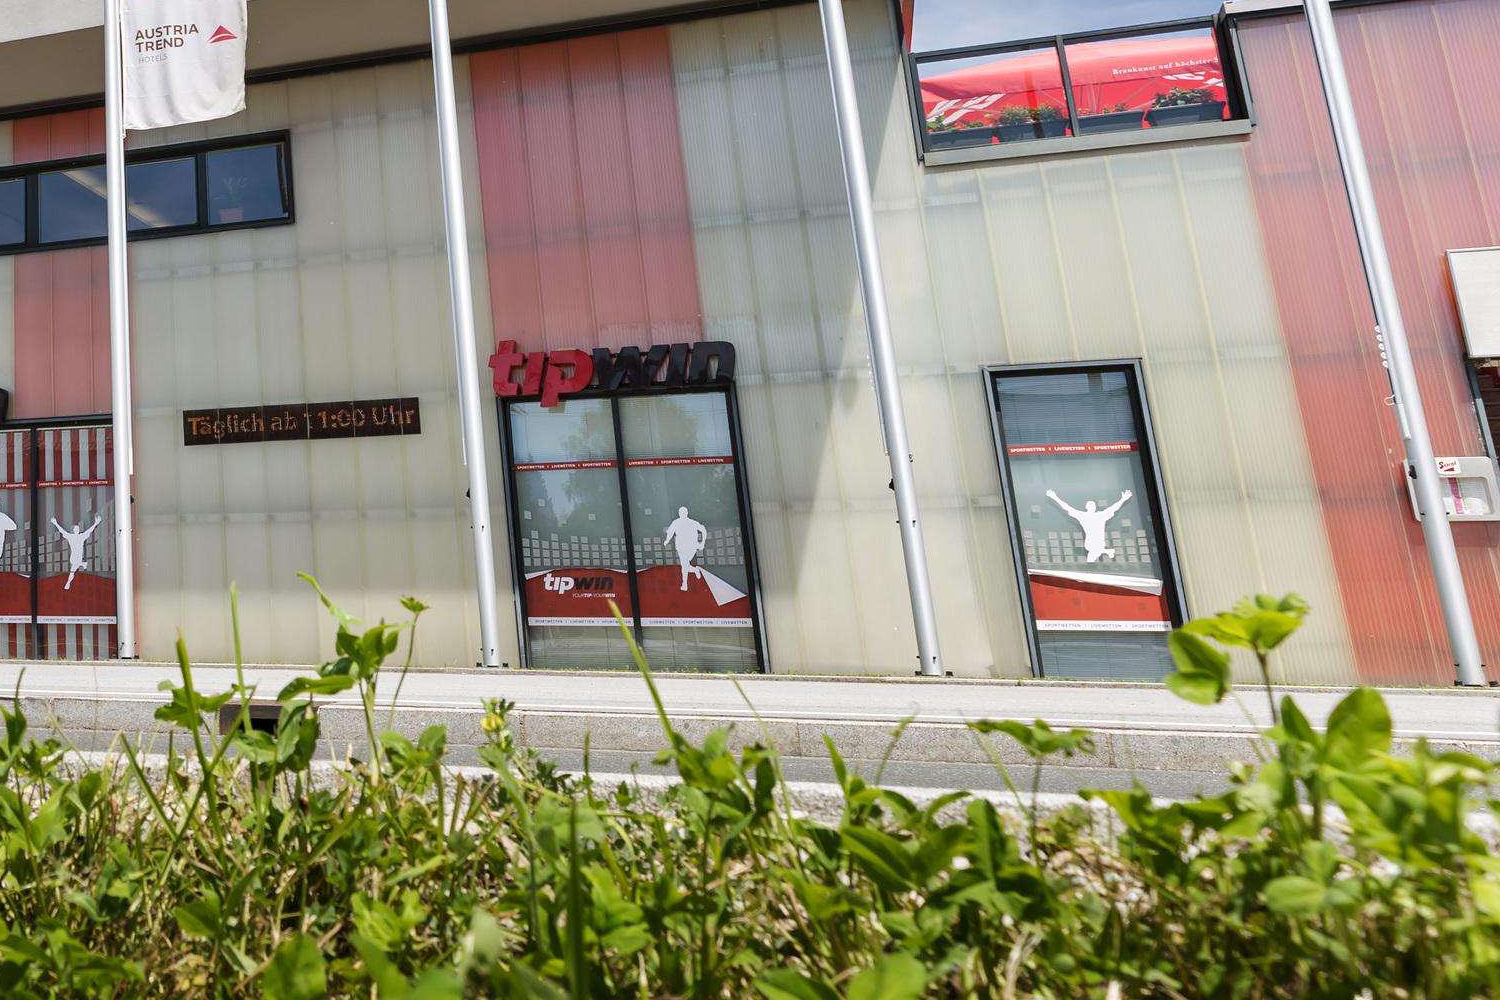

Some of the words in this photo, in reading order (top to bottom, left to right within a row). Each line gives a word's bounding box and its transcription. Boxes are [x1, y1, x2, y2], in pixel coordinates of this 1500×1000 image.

[135, 24, 199, 41] AUSTRIA
[135, 37, 184, 53] TREND
[139, 54, 168, 64] HOTELS
[489, 340, 735, 407] tipwin
[188, 412, 264, 440] Täglich
[271, 411, 297, 431] ab
[371, 404, 415, 426] Uhr
[543, 573, 613, 594] tipwin
